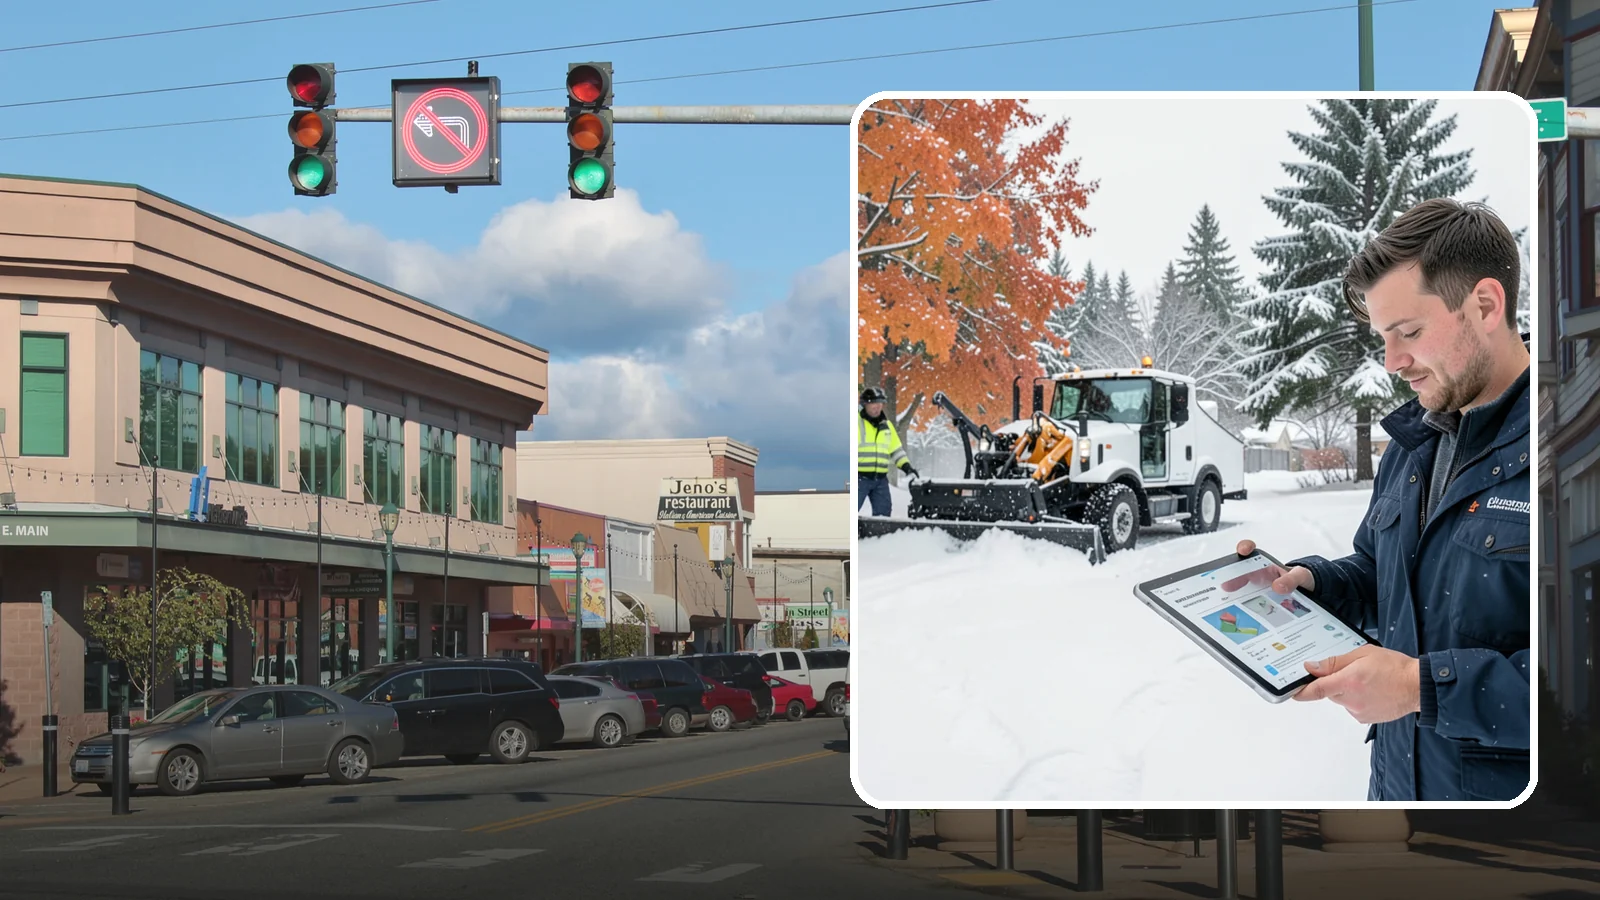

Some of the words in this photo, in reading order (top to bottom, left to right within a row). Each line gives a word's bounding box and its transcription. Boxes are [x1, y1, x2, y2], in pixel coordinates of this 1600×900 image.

[670, 480, 728, 495] Jeno's
[665, 496, 731, 509] restaurant
[659, 510, 682, 519] Italian
[686, 510, 714, 519] American
[715, 509, 738, 519] Cuisine
[2, 525, 13, 536] E.
[16, 525, 49, 536] MAIN
[797, 608, 828, 616] Street
[791, 619, 823, 627] lass
